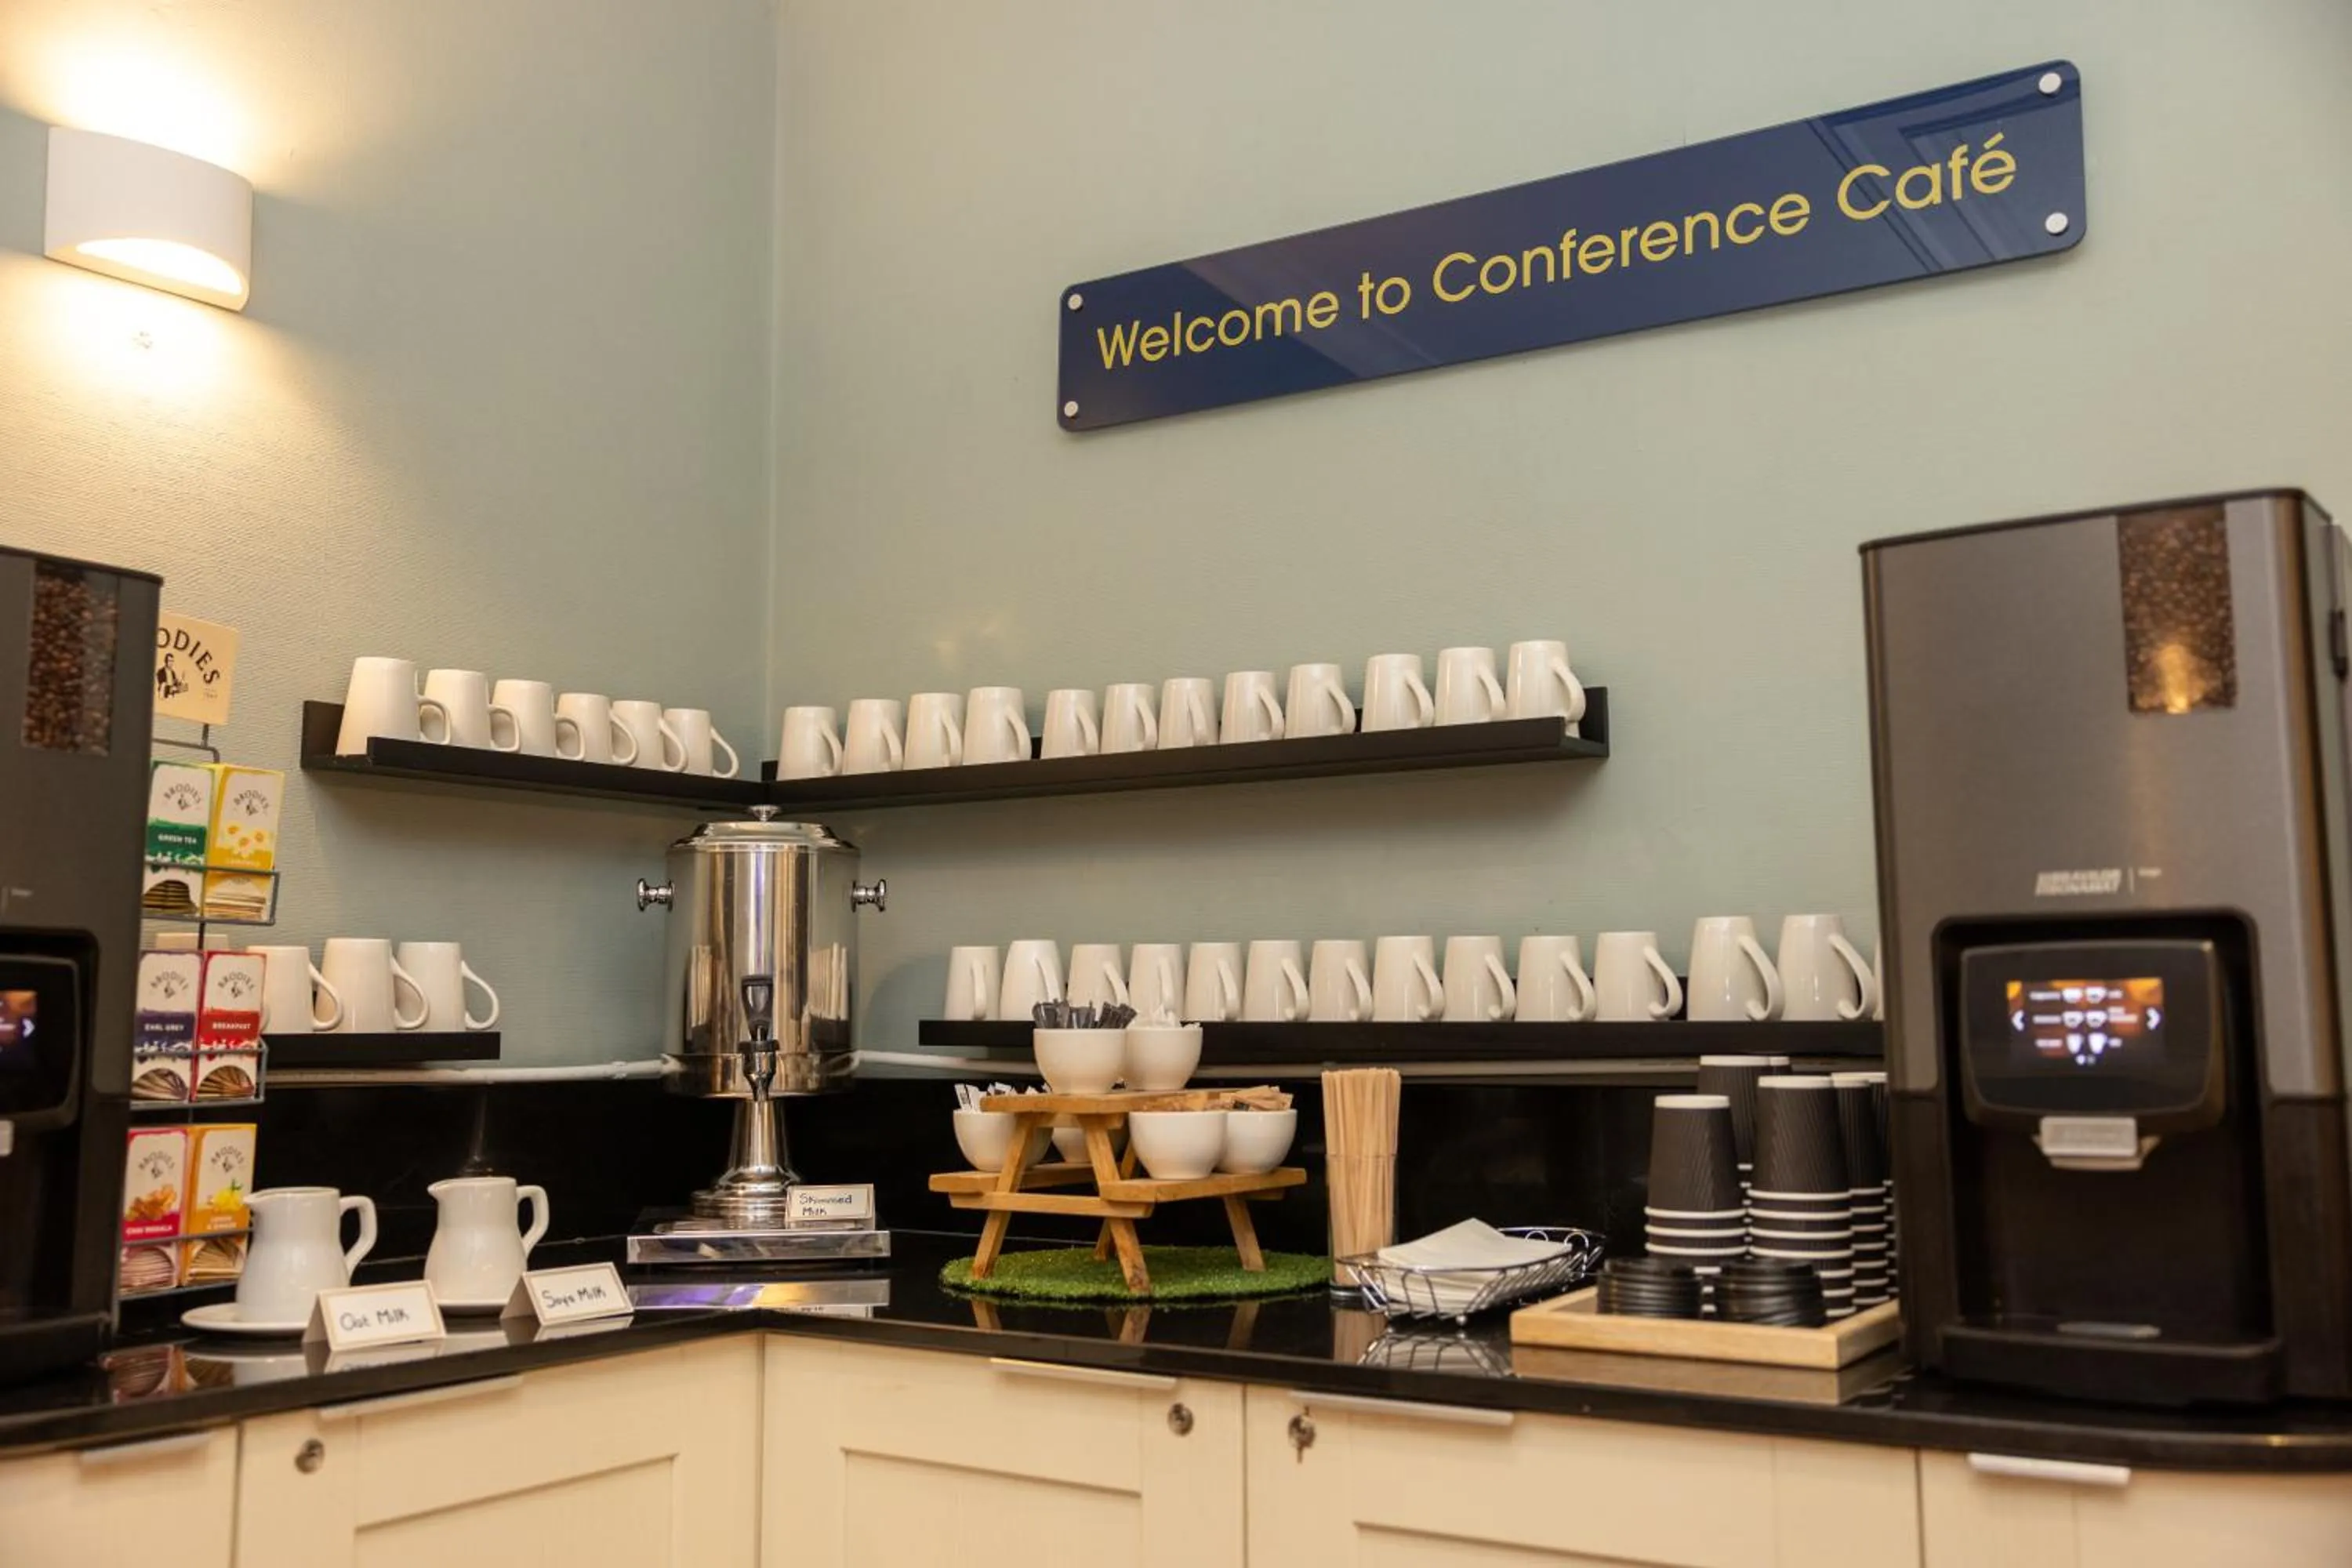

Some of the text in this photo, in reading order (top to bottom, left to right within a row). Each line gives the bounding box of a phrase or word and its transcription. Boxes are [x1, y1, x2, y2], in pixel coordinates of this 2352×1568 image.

[1097, 133, 2017, 369] Welcome to Conference Café
[157, 627, 220, 684] ODIES
[164, 783, 201, 804] BRODIES
[233, 789, 270, 810] BRODIES
[158, 833, 197, 844] GREEN TEA
[577, 1285, 607, 1302] Milk
[339, 1307, 410, 1331] Oat Milk
